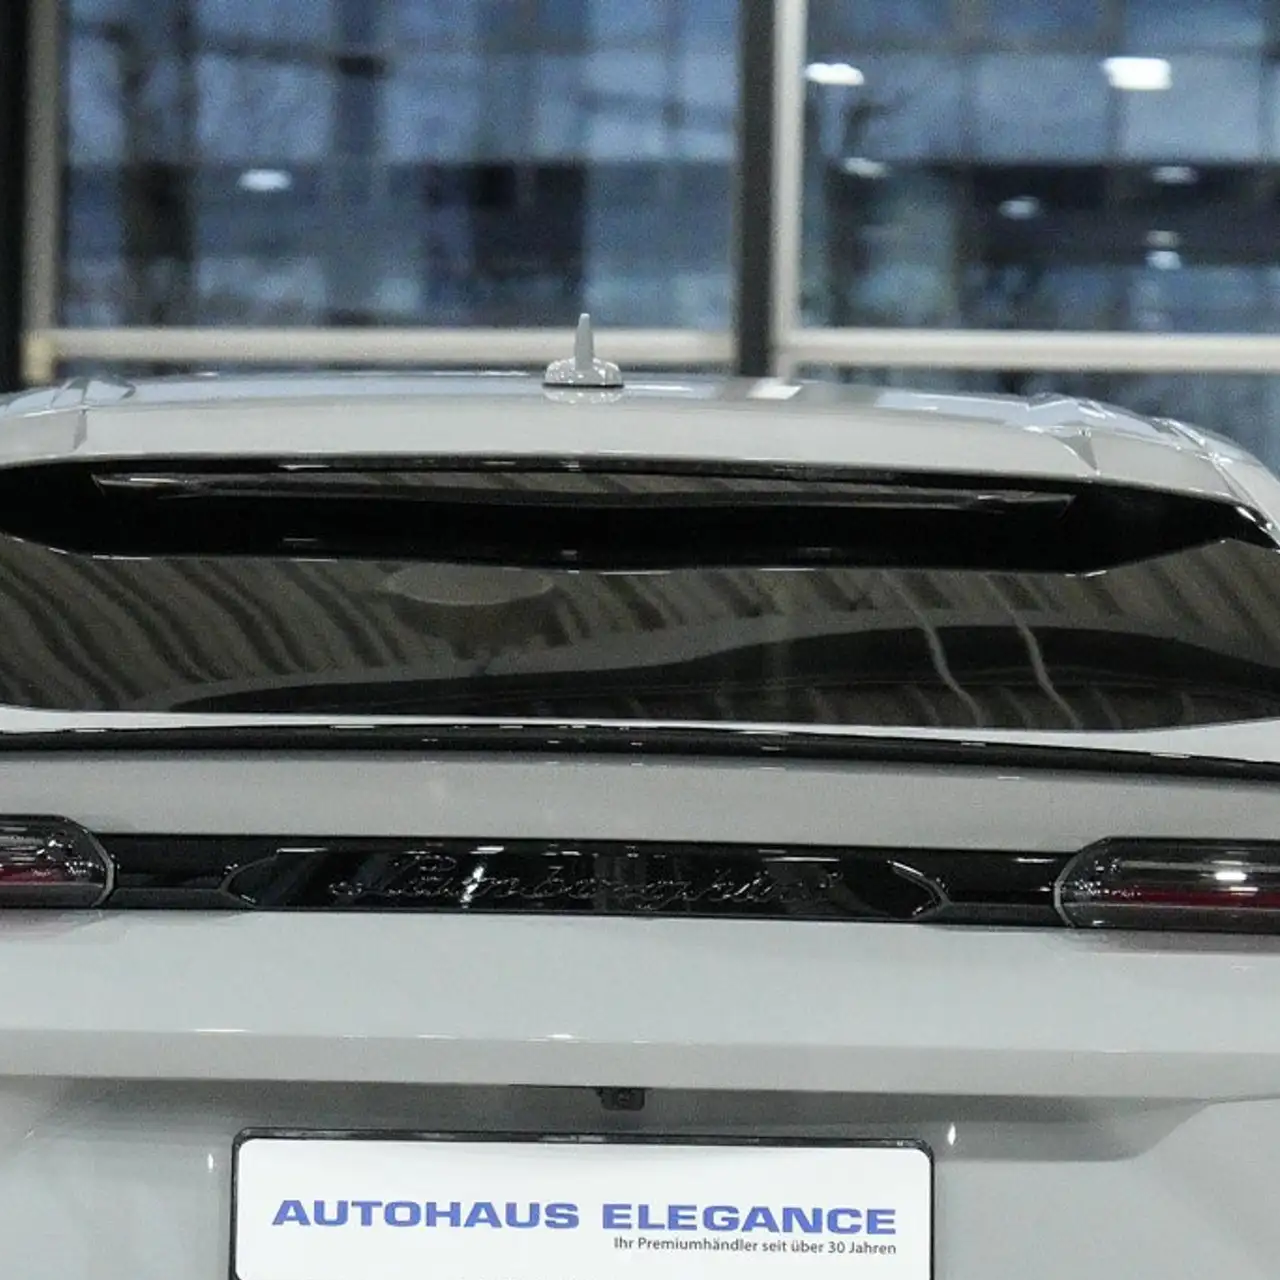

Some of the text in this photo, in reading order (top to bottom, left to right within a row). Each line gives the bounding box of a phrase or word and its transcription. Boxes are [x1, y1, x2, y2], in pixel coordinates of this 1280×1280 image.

[271, 1199, 897, 1235] AUTOHAUS ELEGANCE
[614, 1236, 897, 1255] Ihr Premiumhändler seit über 30 Jahren
